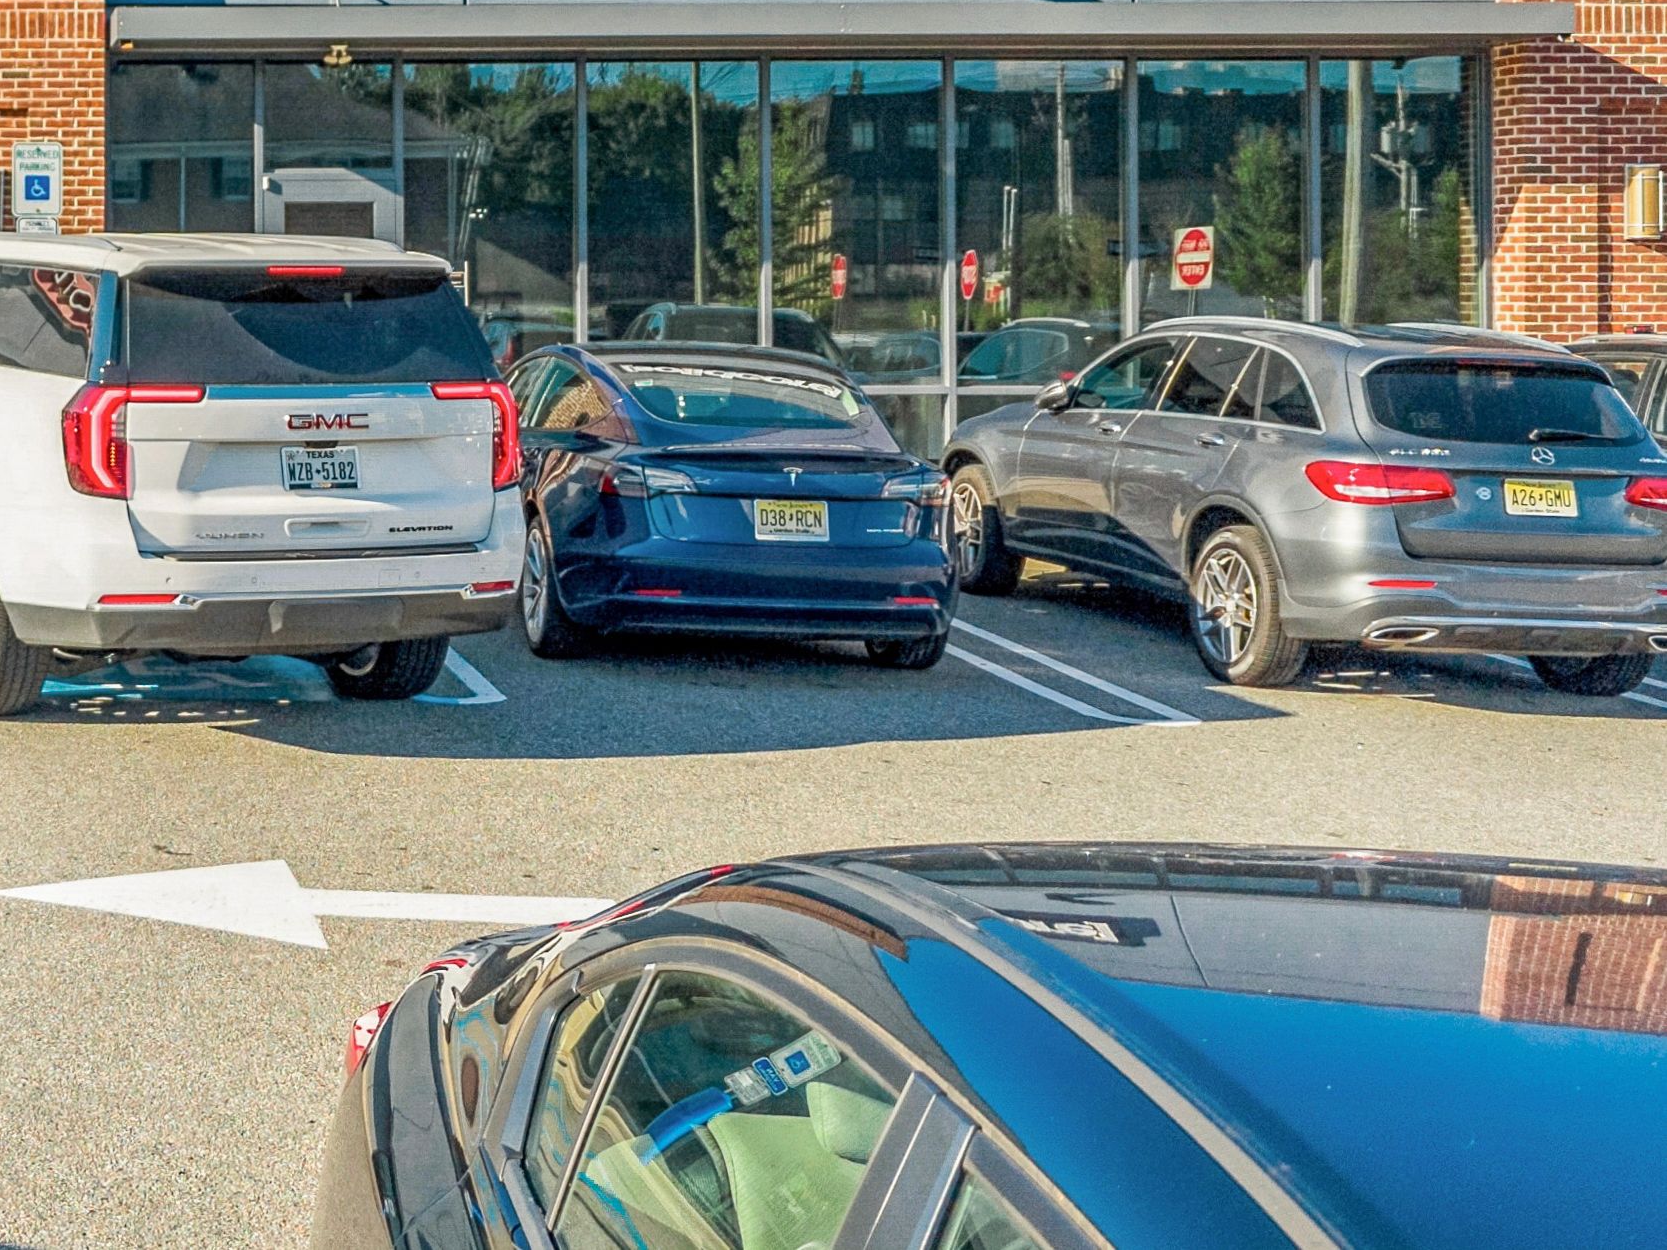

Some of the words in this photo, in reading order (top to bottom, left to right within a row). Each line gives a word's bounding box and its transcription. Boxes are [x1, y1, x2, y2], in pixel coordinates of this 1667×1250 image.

[15, 149, 59, 159] RESERVED
[19, 161, 55, 171] PARKING
[287, 412, 370, 431] GMC
[306, 450, 335, 459] TEXAS
[320, 461, 356, 481] 5182
[388, 524, 454, 533] ELEVATION
